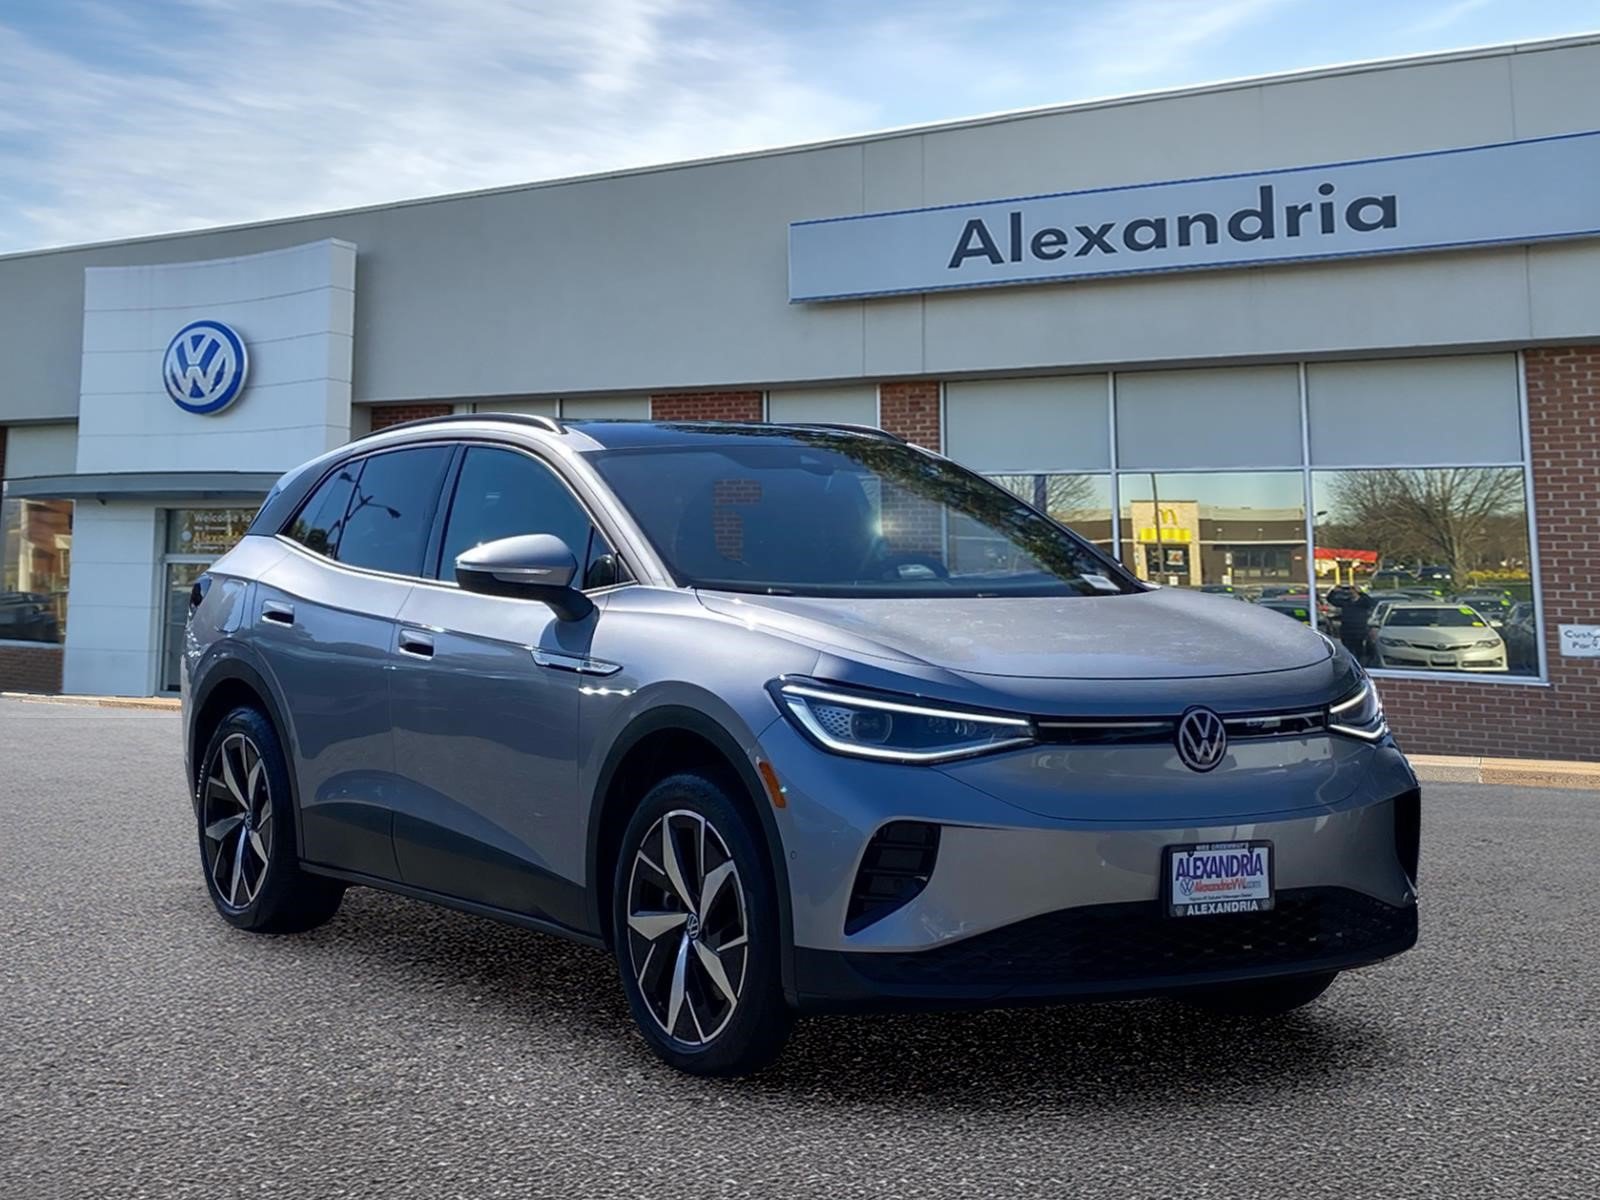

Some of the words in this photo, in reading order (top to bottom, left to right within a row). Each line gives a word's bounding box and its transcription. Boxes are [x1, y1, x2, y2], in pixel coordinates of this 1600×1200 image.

[948, 183, 1398, 269] Alexandria
[166, 325, 239, 408] VW
[193, 513, 239, 523] Welcome
[1179, 709, 1226, 769] VW
[1175, 853, 1264, 881] ALEXANDRIA
[1187, 900, 1259, 916] ALEXANDRIA
